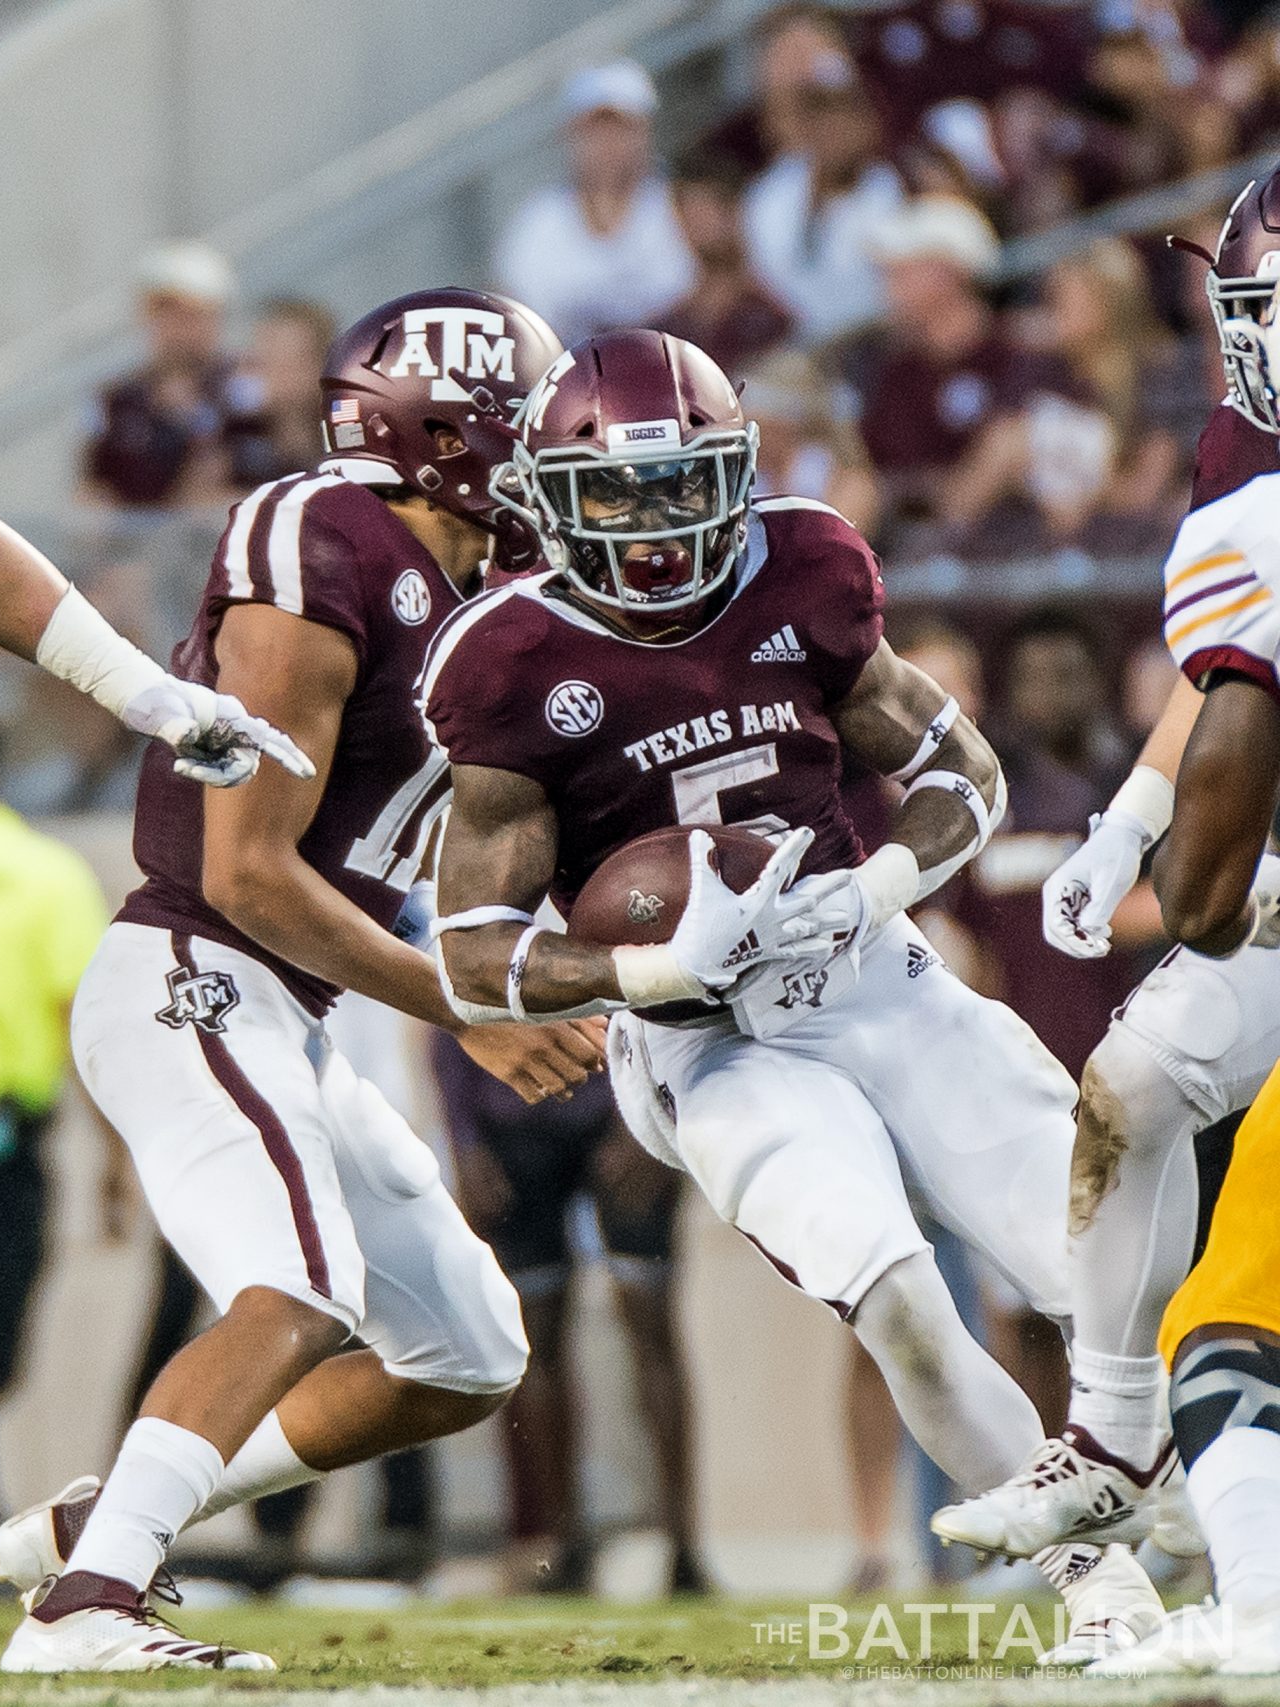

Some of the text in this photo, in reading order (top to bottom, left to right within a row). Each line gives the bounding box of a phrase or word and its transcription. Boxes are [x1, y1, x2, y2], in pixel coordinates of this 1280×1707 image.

[624, 427, 666, 442] AGGIES
[750, 649, 807, 663] adidas
[550, 685, 599, 732] SEC
[623, 701, 803, 772] TEXAS A&M
